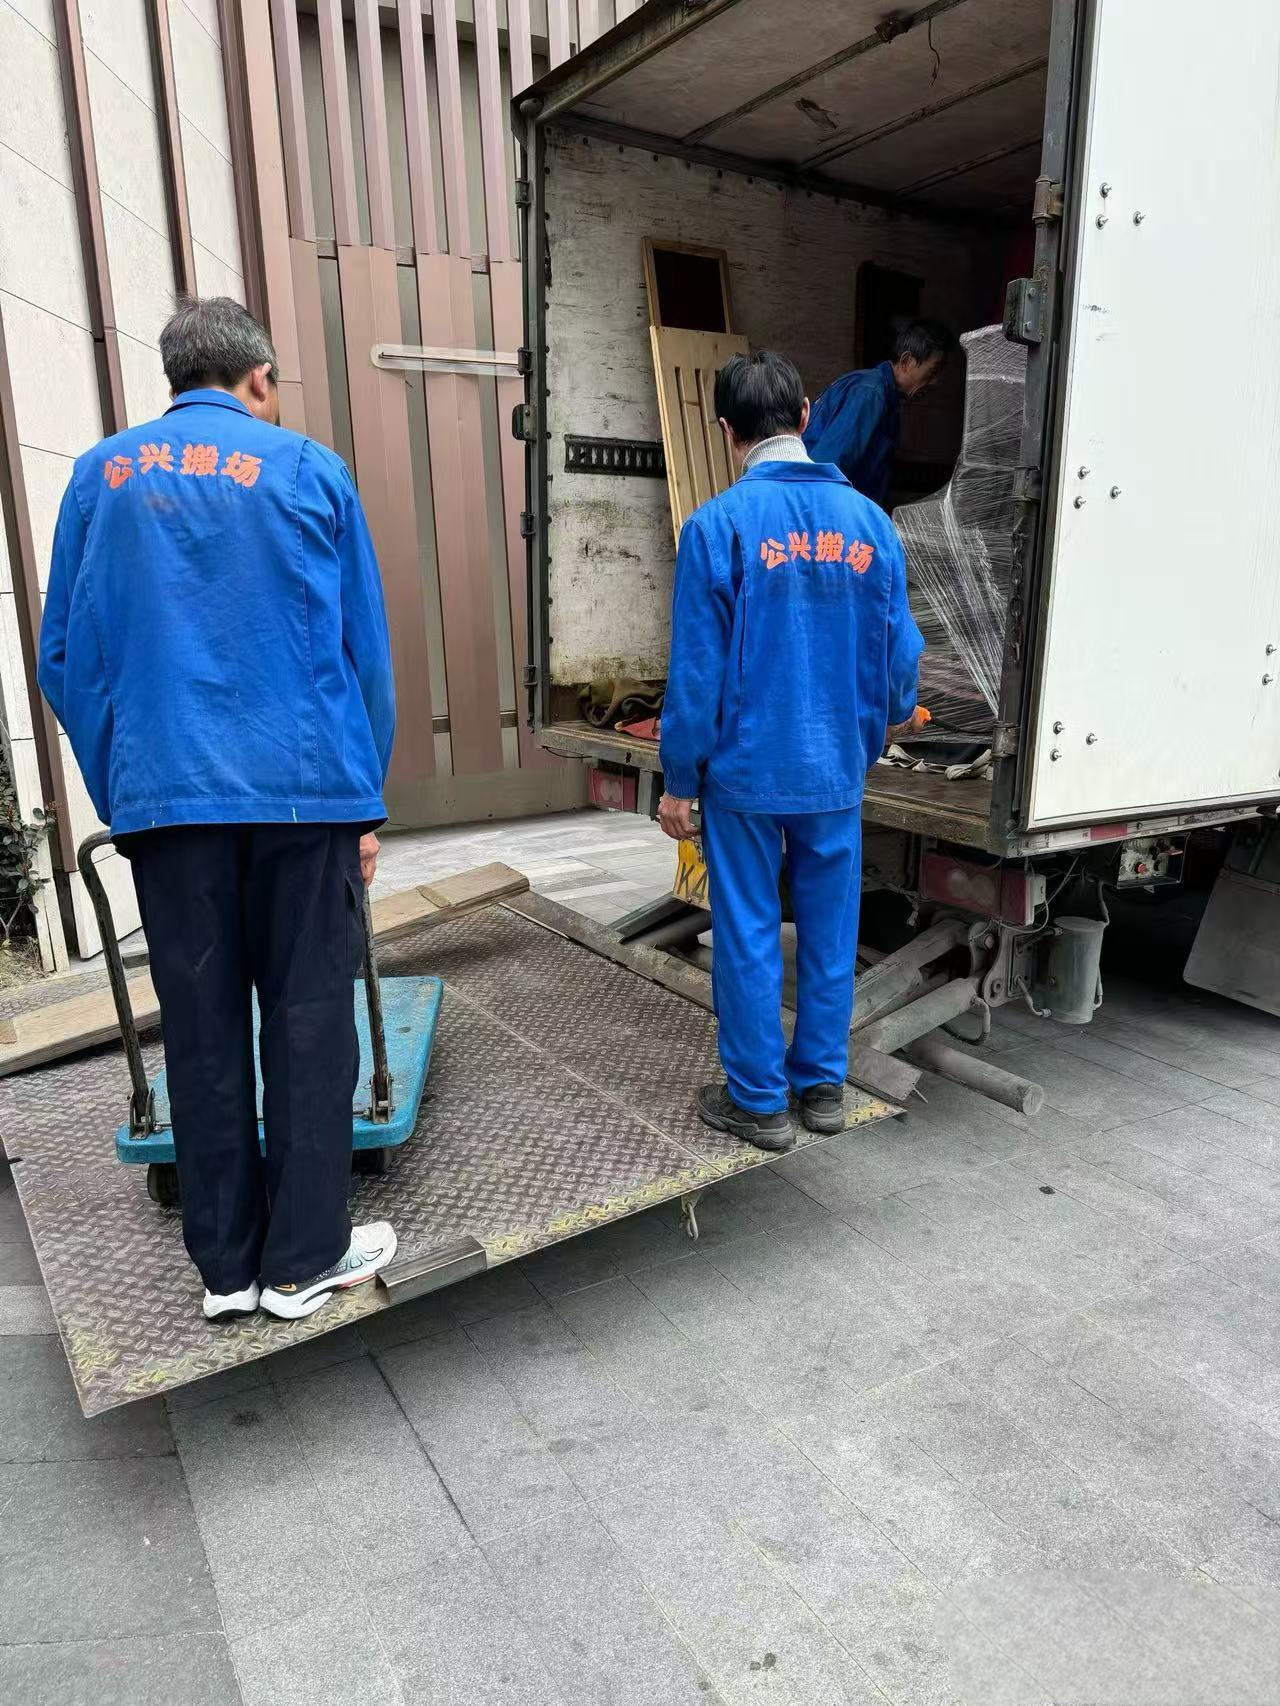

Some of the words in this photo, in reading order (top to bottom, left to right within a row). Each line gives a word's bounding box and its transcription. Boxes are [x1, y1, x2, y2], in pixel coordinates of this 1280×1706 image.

[103, 443, 262, 489] 公兴搬场
[760, 530, 875, 574] 公兴搬场
